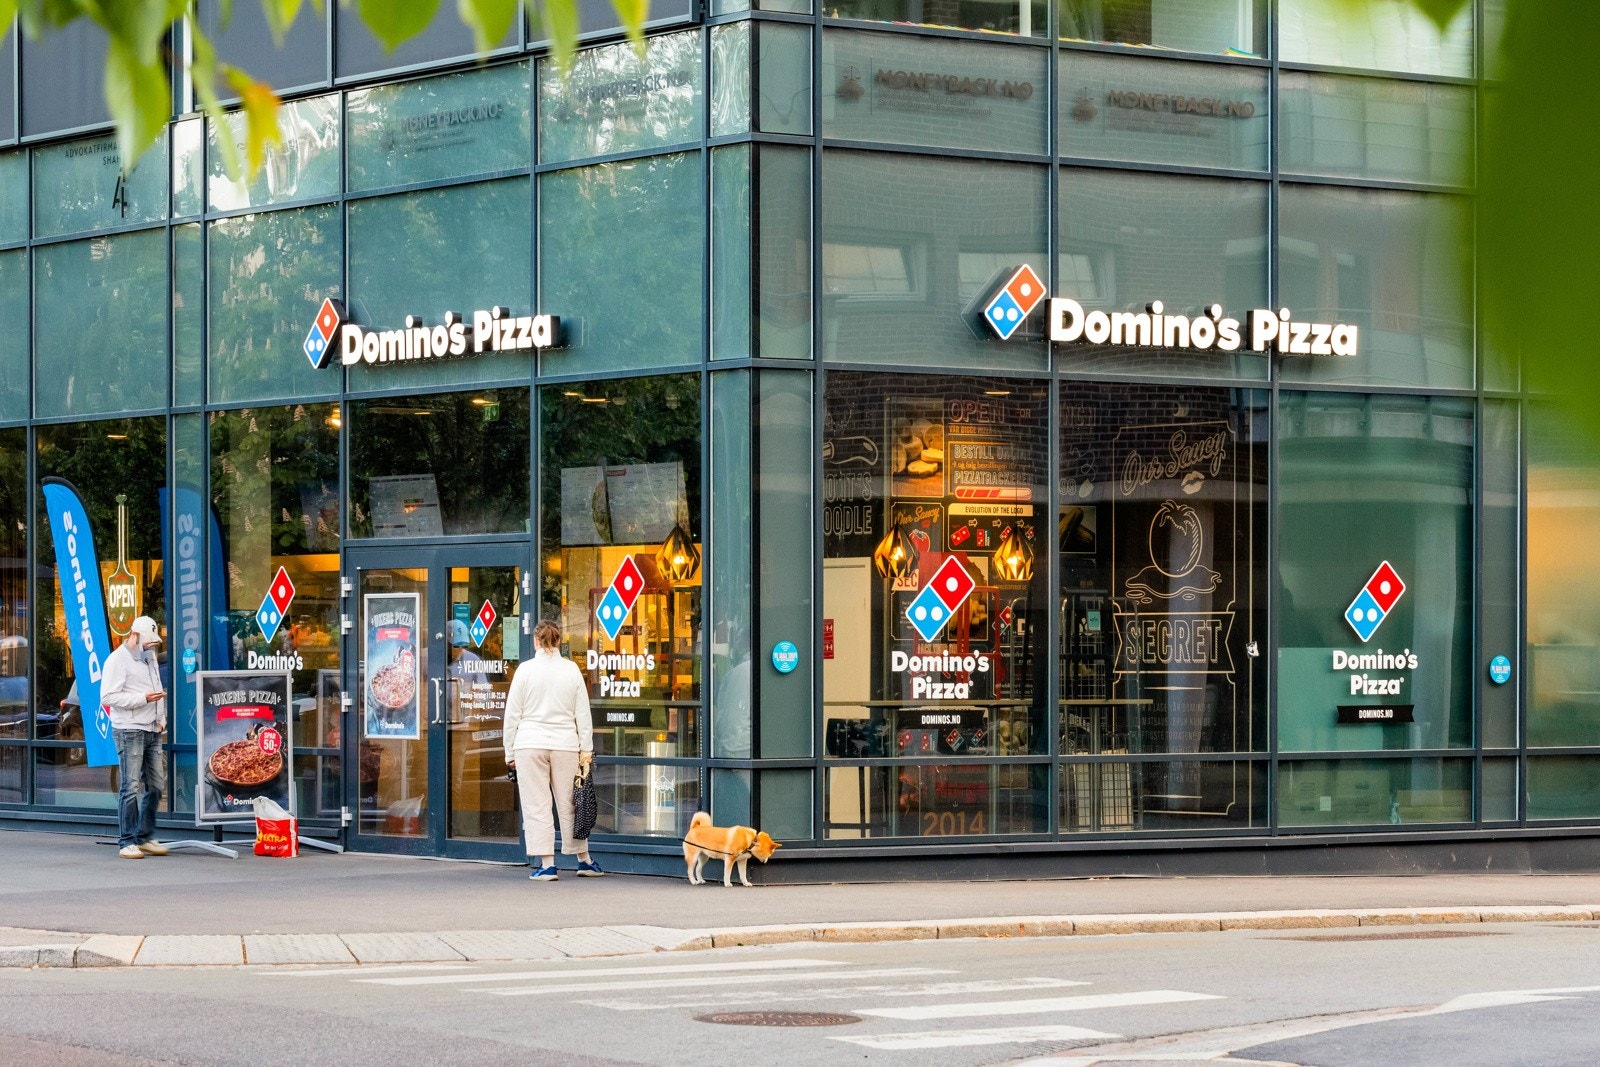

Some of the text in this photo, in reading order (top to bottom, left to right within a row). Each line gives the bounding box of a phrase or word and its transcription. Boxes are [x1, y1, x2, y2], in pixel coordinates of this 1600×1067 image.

[342, 305, 553, 366] Domino's Pizza
[1050, 298, 1358, 356] Domino's Pizza
[947, 399, 1005, 424] OPEN
[954, 444, 994, 460] BESTILL
[1120, 430, 1226, 496] Our Saucy
[965, 506, 991, 514] EVOLUTION
[992, 506, 1000, 514] OF
[1011, 507, 1024, 515] LOGO
[109, 584, 135, 608] OPEN
[1125, 619, 1223, 664] SECRET
[247, 650, 303, 670] Domino's
[463, 660, 503, 675] VELKOMMEN
[586, 648, 655, 671] Domino's
[891, 650, 990, 672] Domino's
[1332, 648, 1418, 670] Domino's
[600, 674, 640, 698] Pizza
[912, 677, 970, 700] Pizza
[1350, 673, 1401, 695] Pizza
[212, 690, 277, 706] UKENS PIZZA
[607, 712, 635, 723] DOMINOS.NO
[921, 714, 961, 725] DOMINOS.NO
[1358, 709, 1393, 719] DOMINOS.NO
[263, 732, 276, 740] SPAR
[923, 811, 986, 836] 2014
